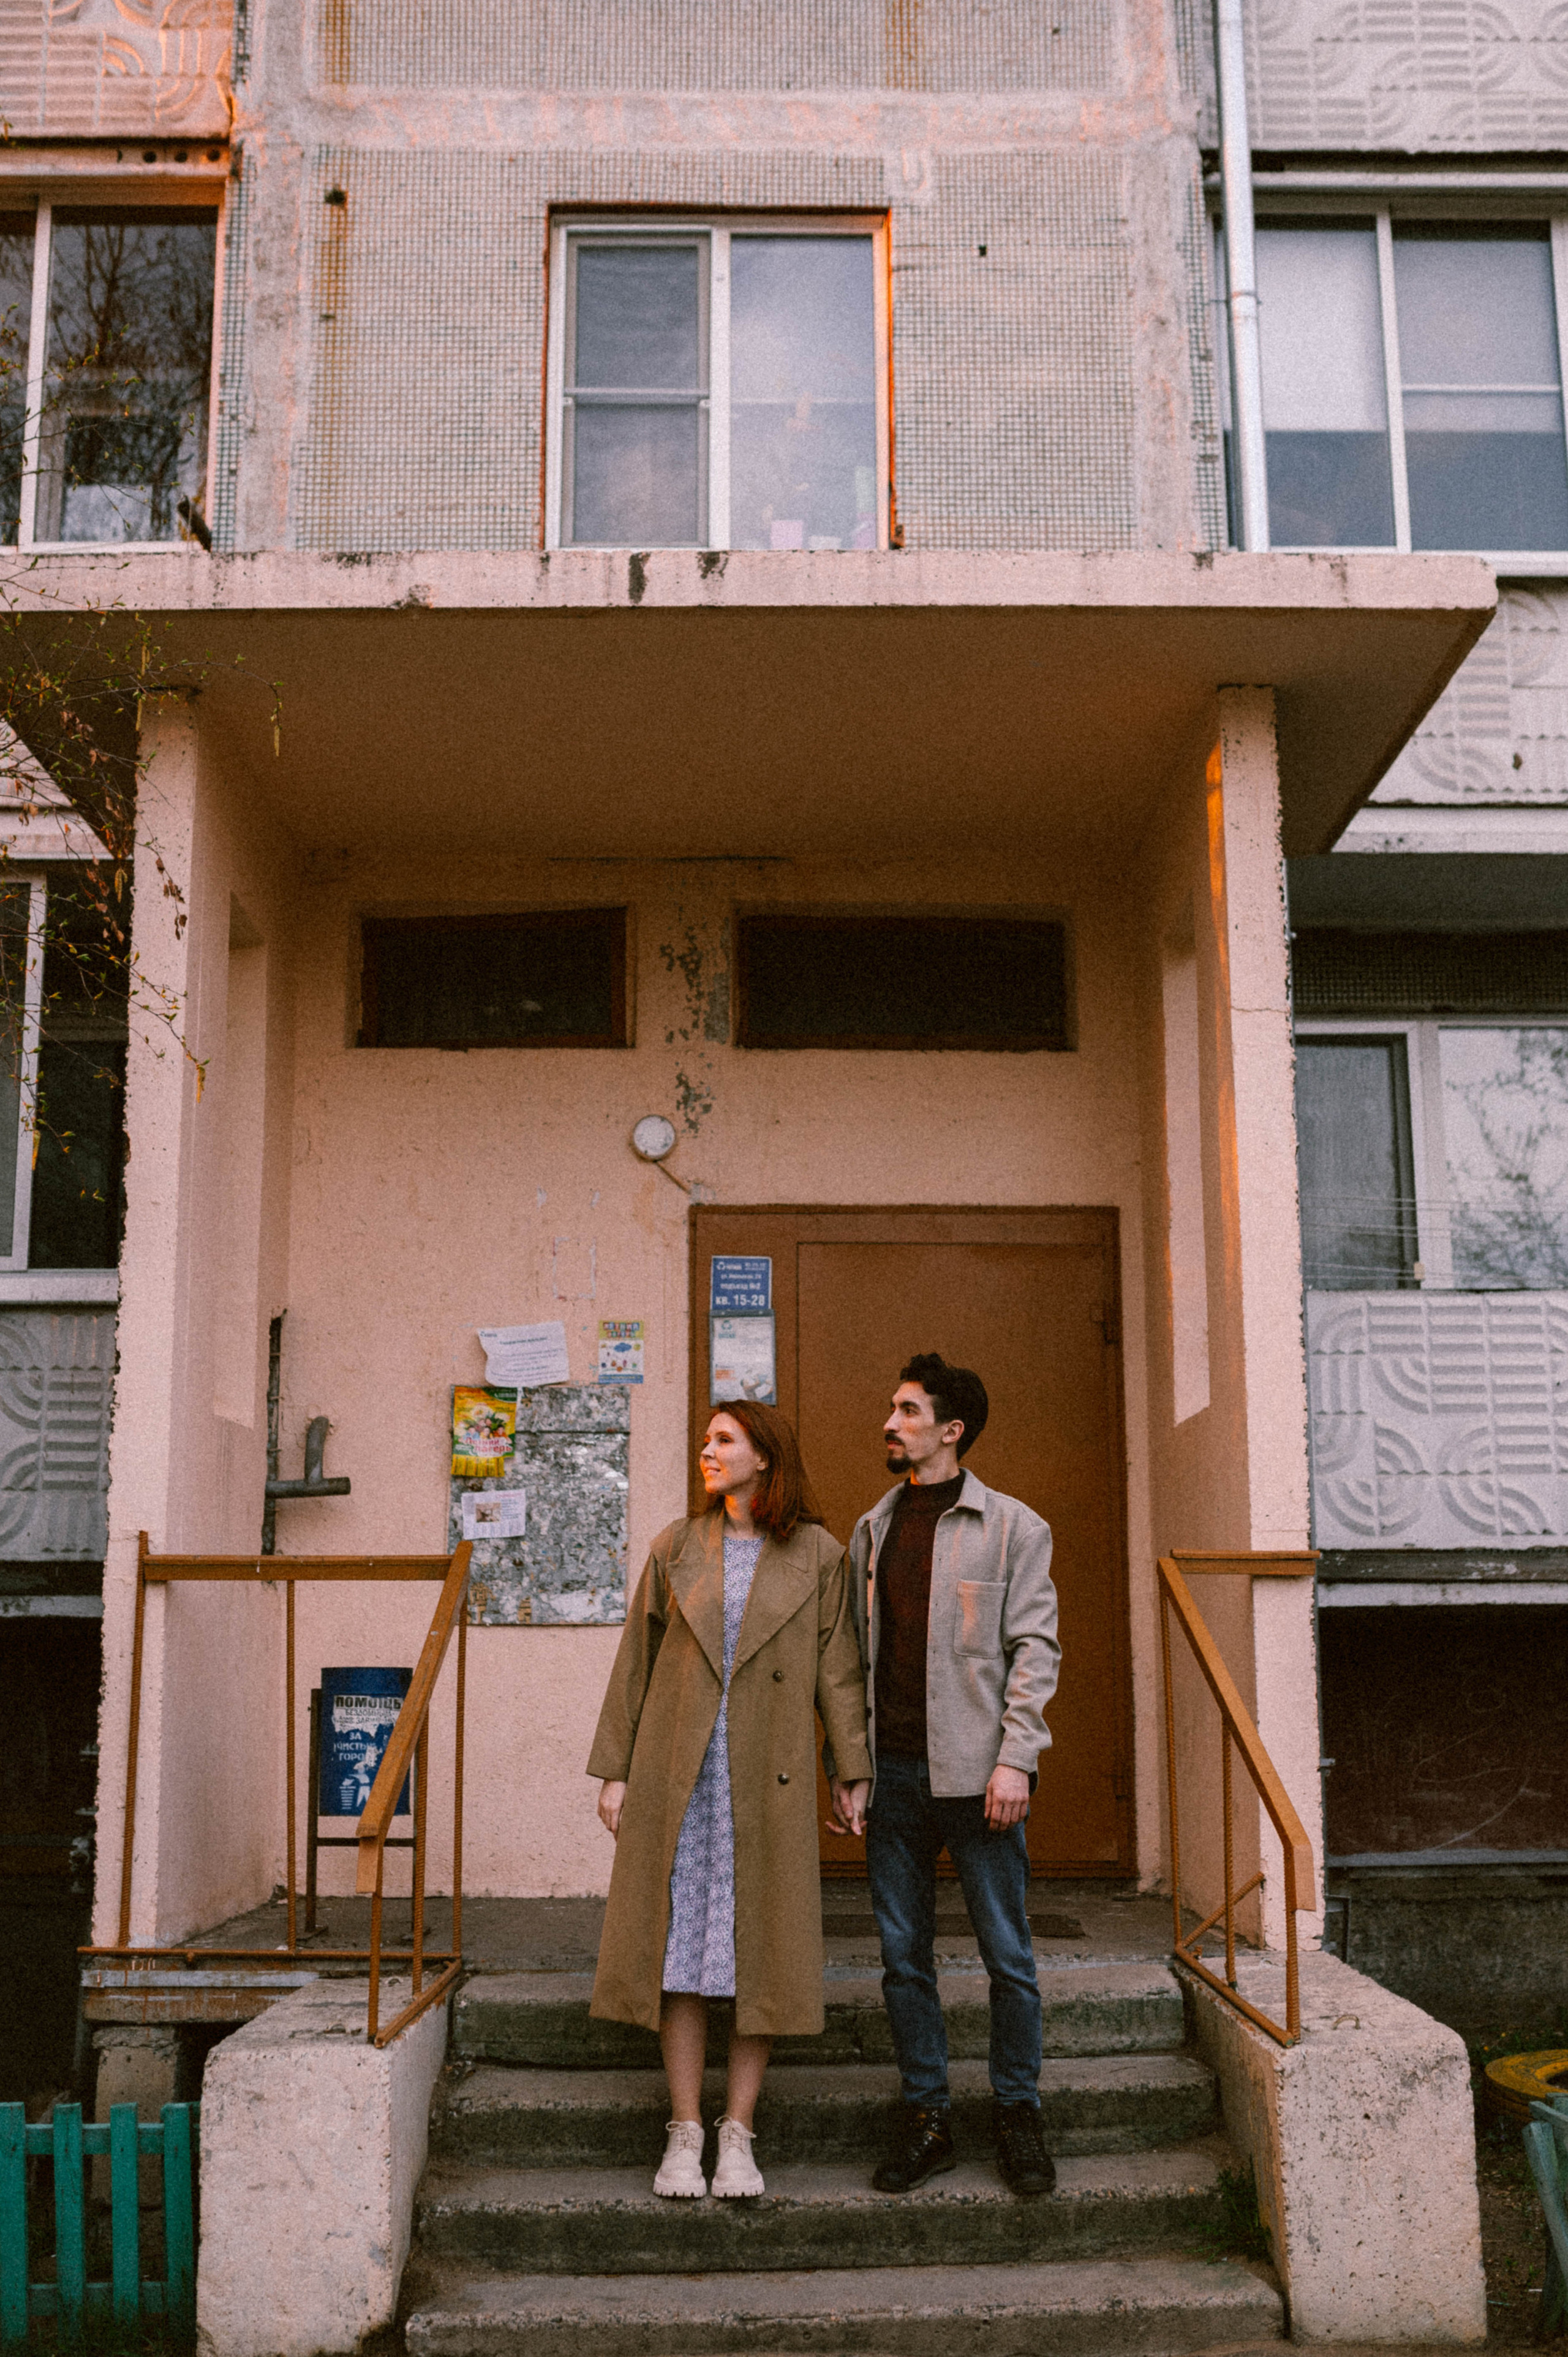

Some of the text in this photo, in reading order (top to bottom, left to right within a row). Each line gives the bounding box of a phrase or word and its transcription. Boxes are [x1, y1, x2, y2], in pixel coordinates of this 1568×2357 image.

[715, 1294, 765, 1306] кв. 15-28
[336, 1696, 401, 1710] ПОМОЩЬ
[349, 1731, 362, 1740] ЗА
[339, 1752, 373, 1761] ГОРО
